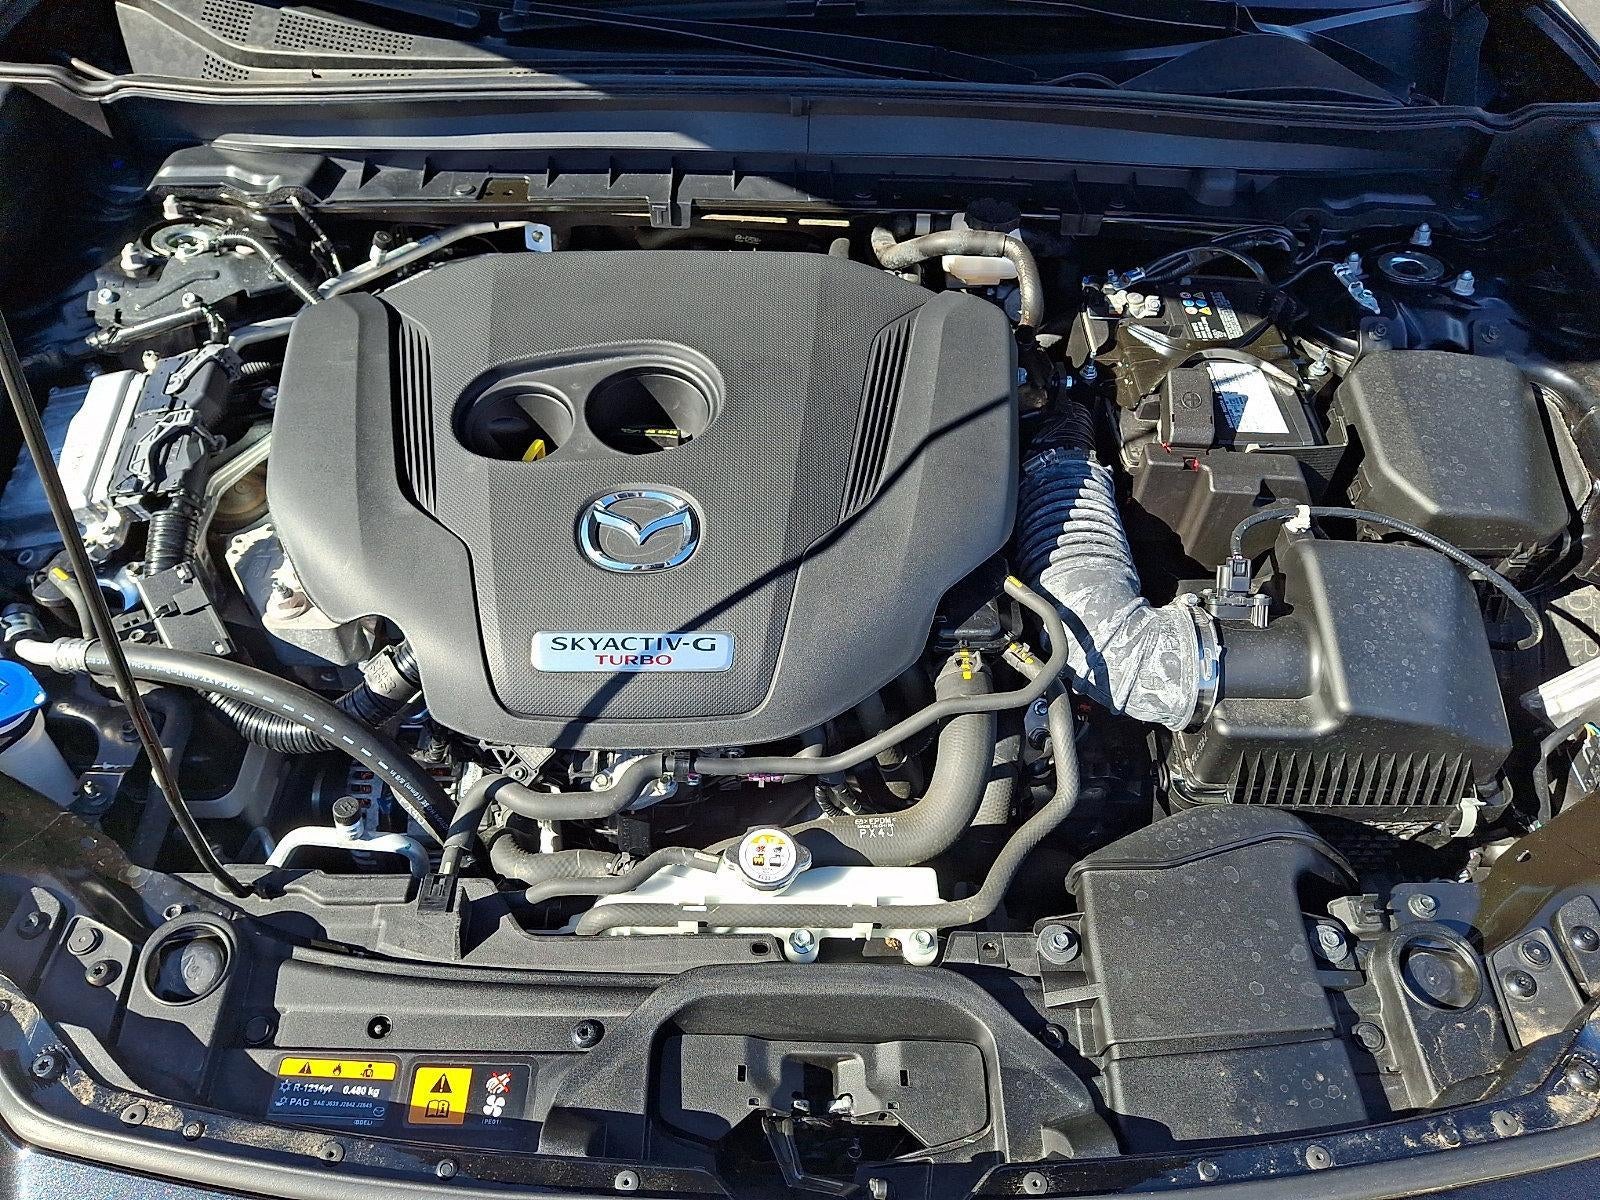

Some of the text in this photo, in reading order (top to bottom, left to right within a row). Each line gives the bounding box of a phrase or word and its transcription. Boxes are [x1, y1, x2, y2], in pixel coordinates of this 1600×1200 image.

[550, 637, 716, 651] SKYACTIV-G
[595, 654, 672, 665] TURBO
[292, 1083, 380, 1098] R-1234yf 0.480 kg
[289, 1098, 310, 1107] PAG
